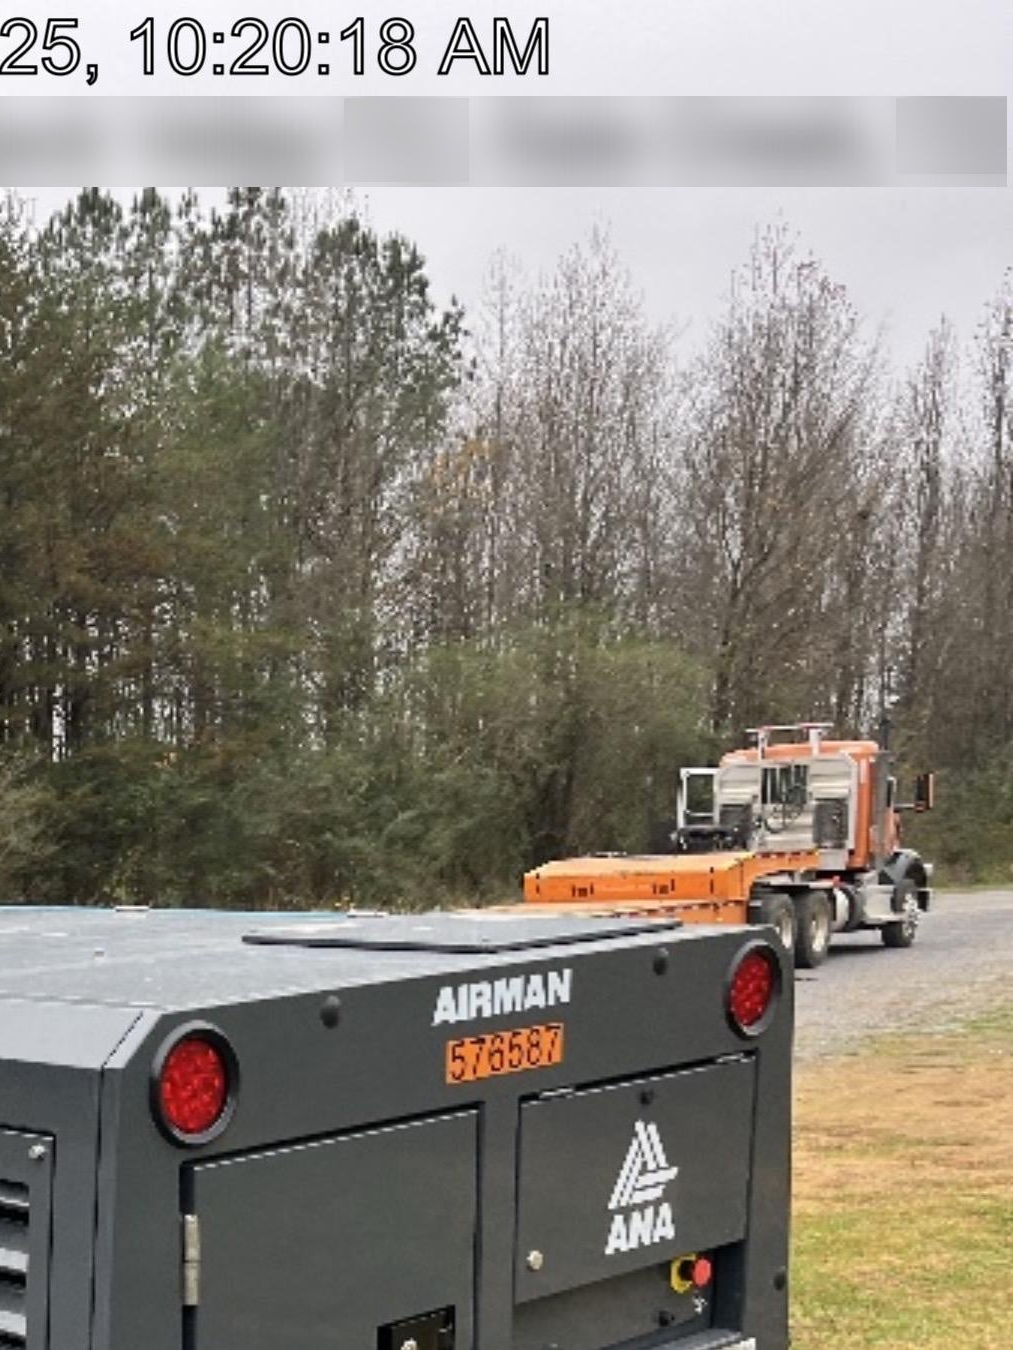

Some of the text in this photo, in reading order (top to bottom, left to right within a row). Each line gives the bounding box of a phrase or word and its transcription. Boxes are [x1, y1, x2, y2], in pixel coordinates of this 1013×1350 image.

[431, 968, 573, 1026] AIRMAN
[449, 1025, 563, 1082] 576587
[604, 1203, 676, 1256] ANA
